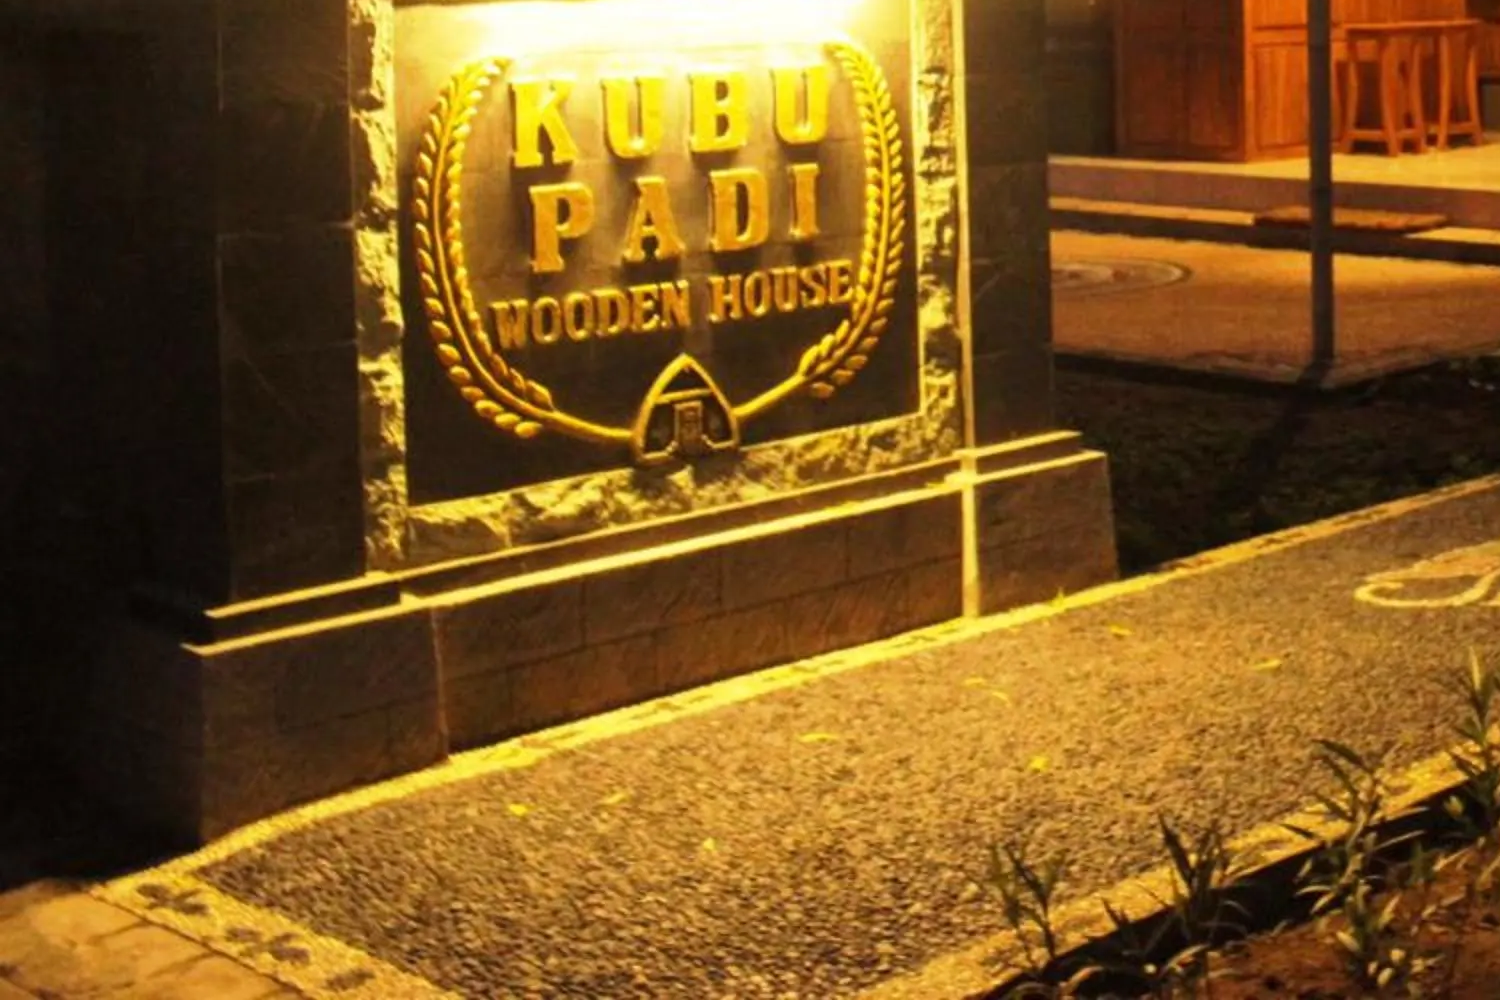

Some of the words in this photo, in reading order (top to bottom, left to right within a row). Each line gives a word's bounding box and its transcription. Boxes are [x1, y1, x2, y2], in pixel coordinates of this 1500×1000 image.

[508, 64, 831, 169] KUBU
[529, 163, 820, 273] PADI
[491, 279, 692, 350] WOODEN
[706, 259, 854, 324] HOUSE
